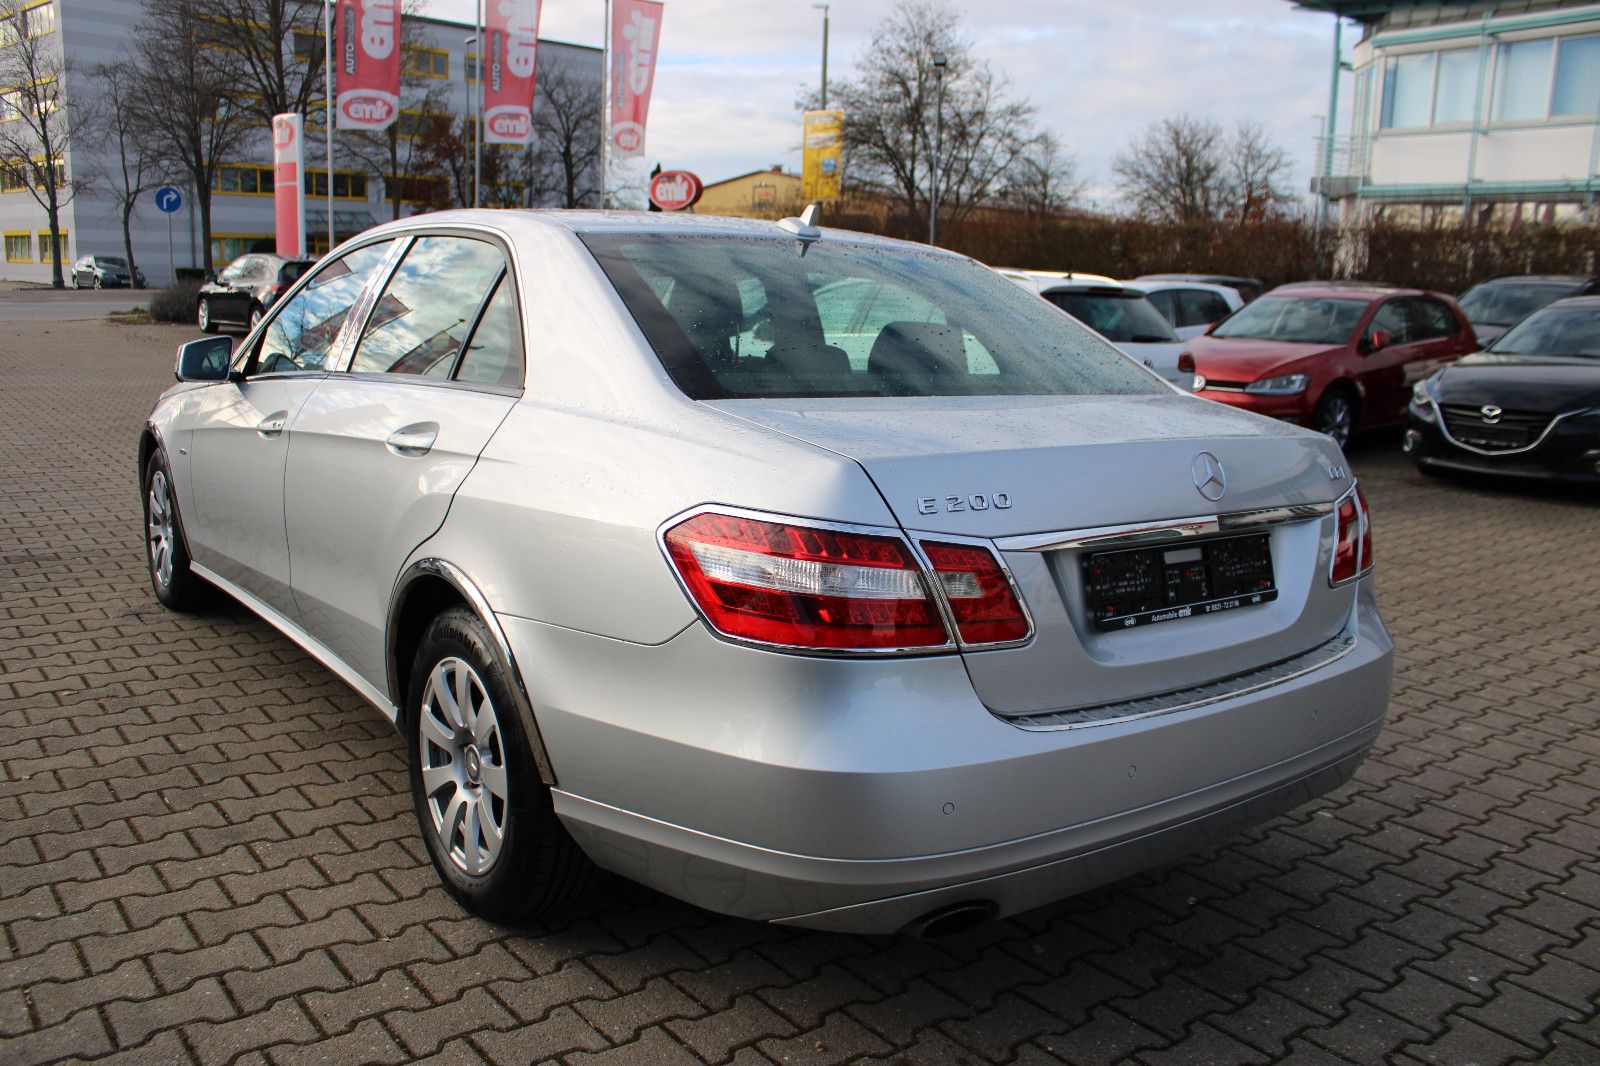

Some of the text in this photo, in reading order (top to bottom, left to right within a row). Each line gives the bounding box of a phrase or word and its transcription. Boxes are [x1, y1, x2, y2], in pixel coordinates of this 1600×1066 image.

[655, 174, 689, 202] emir
[917, 491, 1012, 515] E 200
